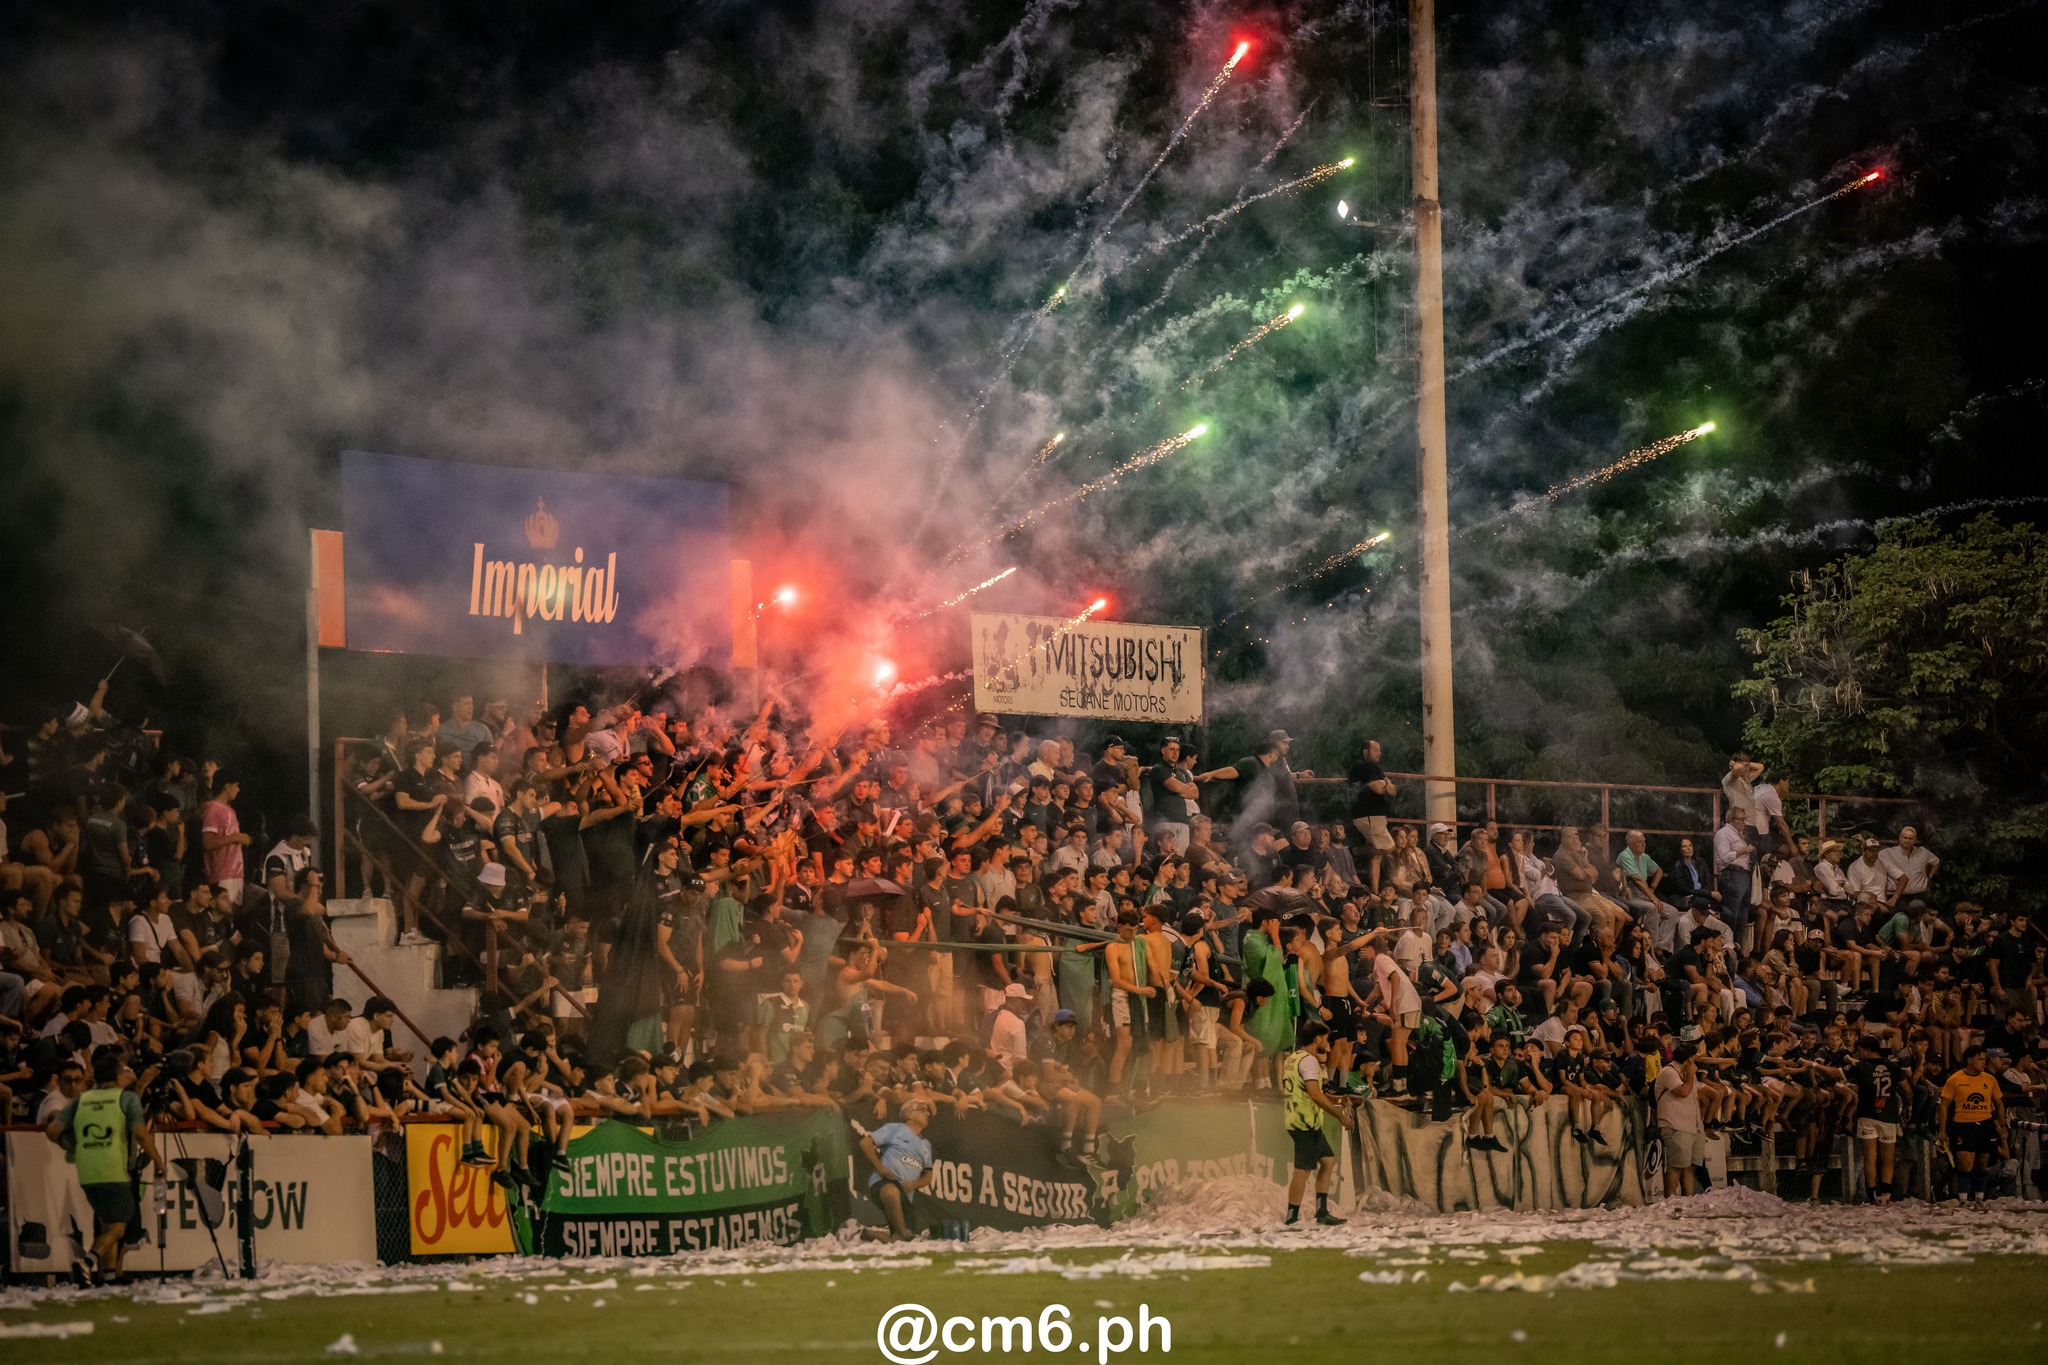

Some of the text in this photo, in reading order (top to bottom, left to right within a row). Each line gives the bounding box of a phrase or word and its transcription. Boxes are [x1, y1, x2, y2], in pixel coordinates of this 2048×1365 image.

[468, 542, 620, 635] Imperial
[1046, 632, 1182, 684] MITSUBISHI
[993, 695, 1014, 705] MOTORS
[1060, 689, 1167, 714] SEOANE MOTORS
[1873, 1076, 1892, 1097] 12
[1961, 1103, 1988, 1111] Macro
[559, 1152, 658, 1197] SIEMPRE
[979, 1165, 999, 1207] A
[1002, 1171, 1088, 1219] SEGUIR
[563, 1203, 802, 1258] SIEMPRE ESTAREMOS
